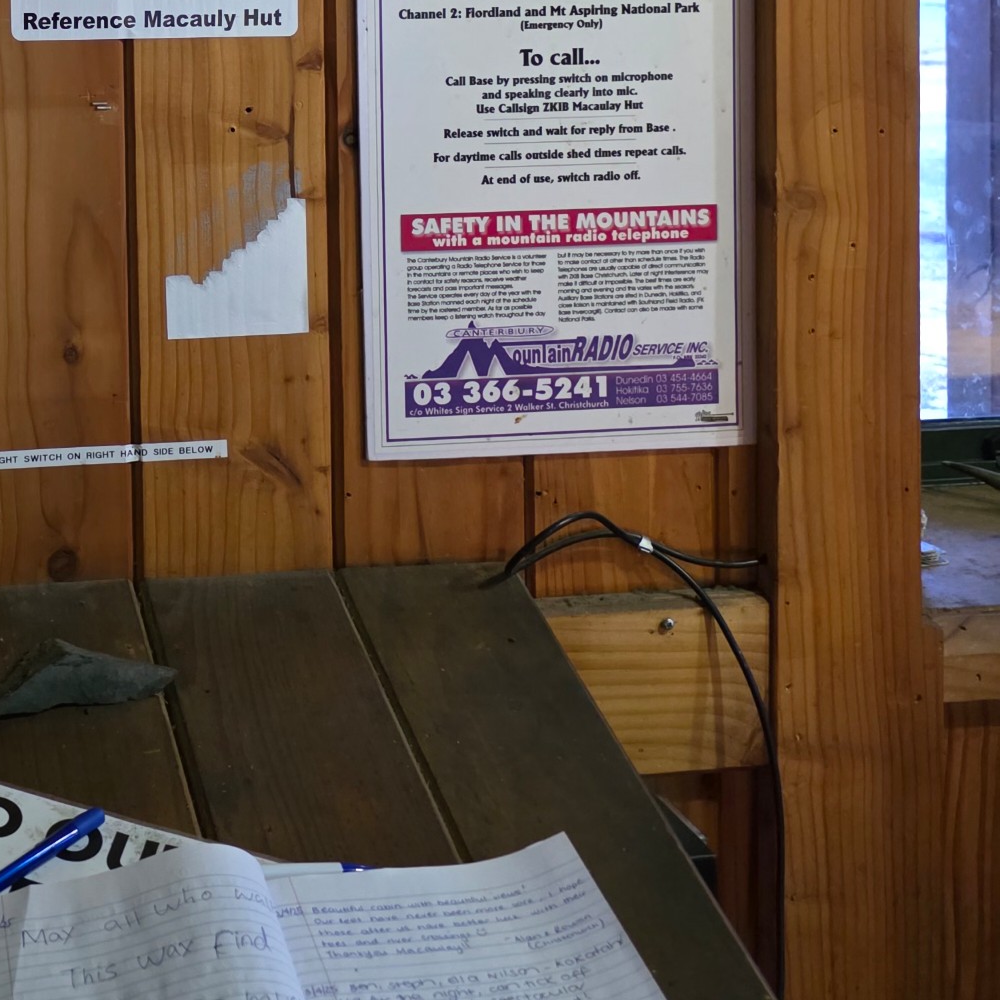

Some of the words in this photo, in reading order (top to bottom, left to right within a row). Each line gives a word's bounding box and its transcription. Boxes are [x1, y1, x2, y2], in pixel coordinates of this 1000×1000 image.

[24, 12, 136, 30] Reference
[144, 9, 236, 31] Macauly
[244, 8, 282, 26] Hut
[519, 49, 543, 66] To
[550, 48, 600, 65] call...
[412, 216, 489, 236] SAFETY
[497, 216, 520, 232] IN
[529, 214, 568, 230] THE
[576, 209, 710, 229] MOUNTAINS
[433, 234, 466, 246] with
[472, 237, 481, 245] a
[488, 231, 560, 245] mountain
[566, 230, 606, 242] radio
[612, 227, 688, 242] telephone
[454, 327, 544, 338] CANTERBURY
[633, 343, 684, 356] SERVICE
[686, 342, 709, 354] INC.
[616, 375, 653, 386] Dunedin
[656, 374, 667, 384] 03
[670, 372, 713, 383] 454-4664
[414, 382, 451, 405] 03
[463, 376, 607, 403] 366-5241
[409, 407, 423, 416] c/o
[425, 405, 453, 415] Whites
[455, 405, 472, 416] Sign
[476, 404, 505, 413] Service
[507, 403, 512, 412] 2
[515, 402, 544, 411] Walker
[546, 401, 556, 410] St.
[559, 400, 609, 410] Christchurch
[24, 454, 62, 462] SWITCH
[67, 452, 80, 460] ON
[86, 451, 115, 459] RIGHT
[120, 448, 148, 458] HAND
[179, 446, 213, 454] BELOW
[153, 889, 212, 917] who
[61, 962, 119, 990] This
